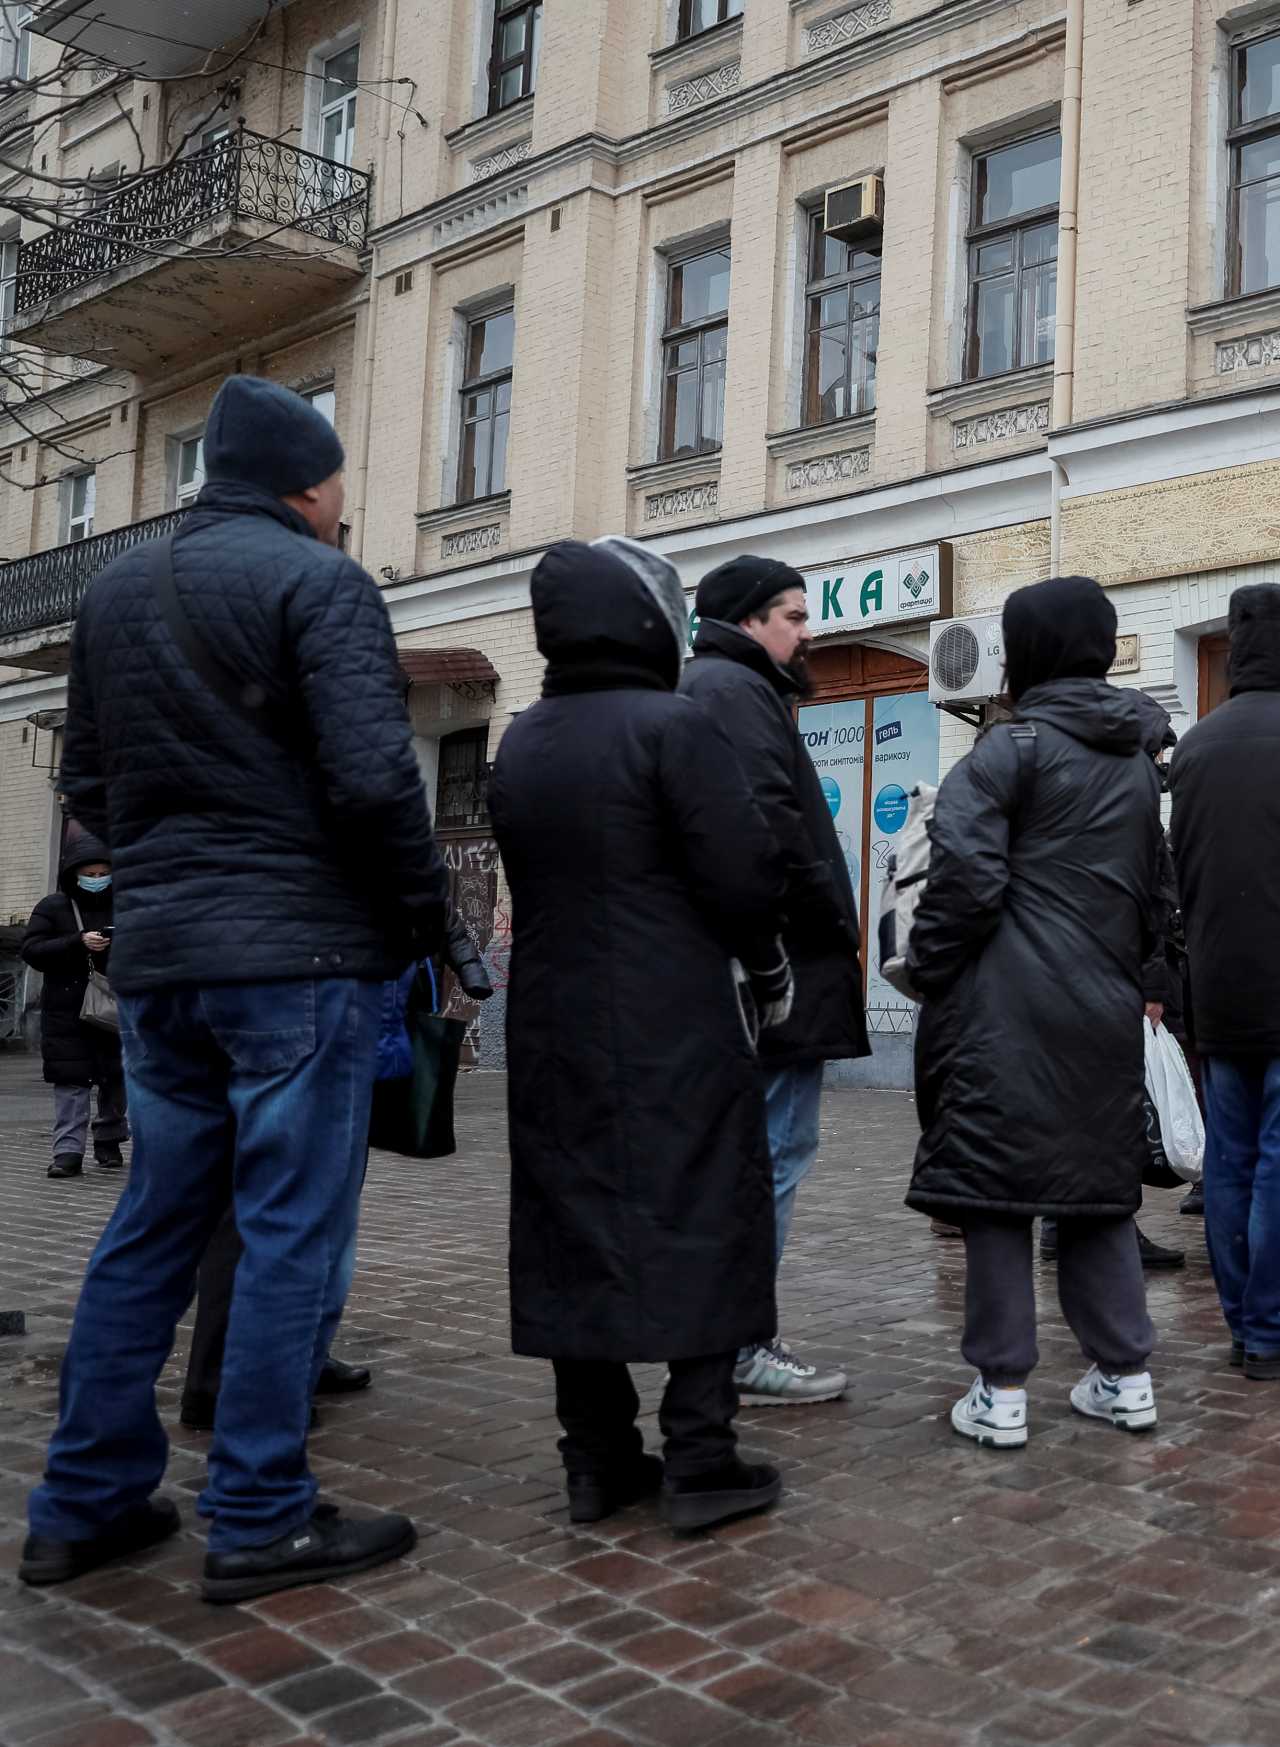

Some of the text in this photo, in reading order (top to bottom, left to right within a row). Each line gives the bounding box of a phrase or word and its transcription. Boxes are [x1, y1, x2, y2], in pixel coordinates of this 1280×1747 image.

[987, 646, 1000, 657] LG
[833, 725, 865, 745] 1000
[878, 725, 900, 742] гель
[874, 751, 911, 763] варикозу
